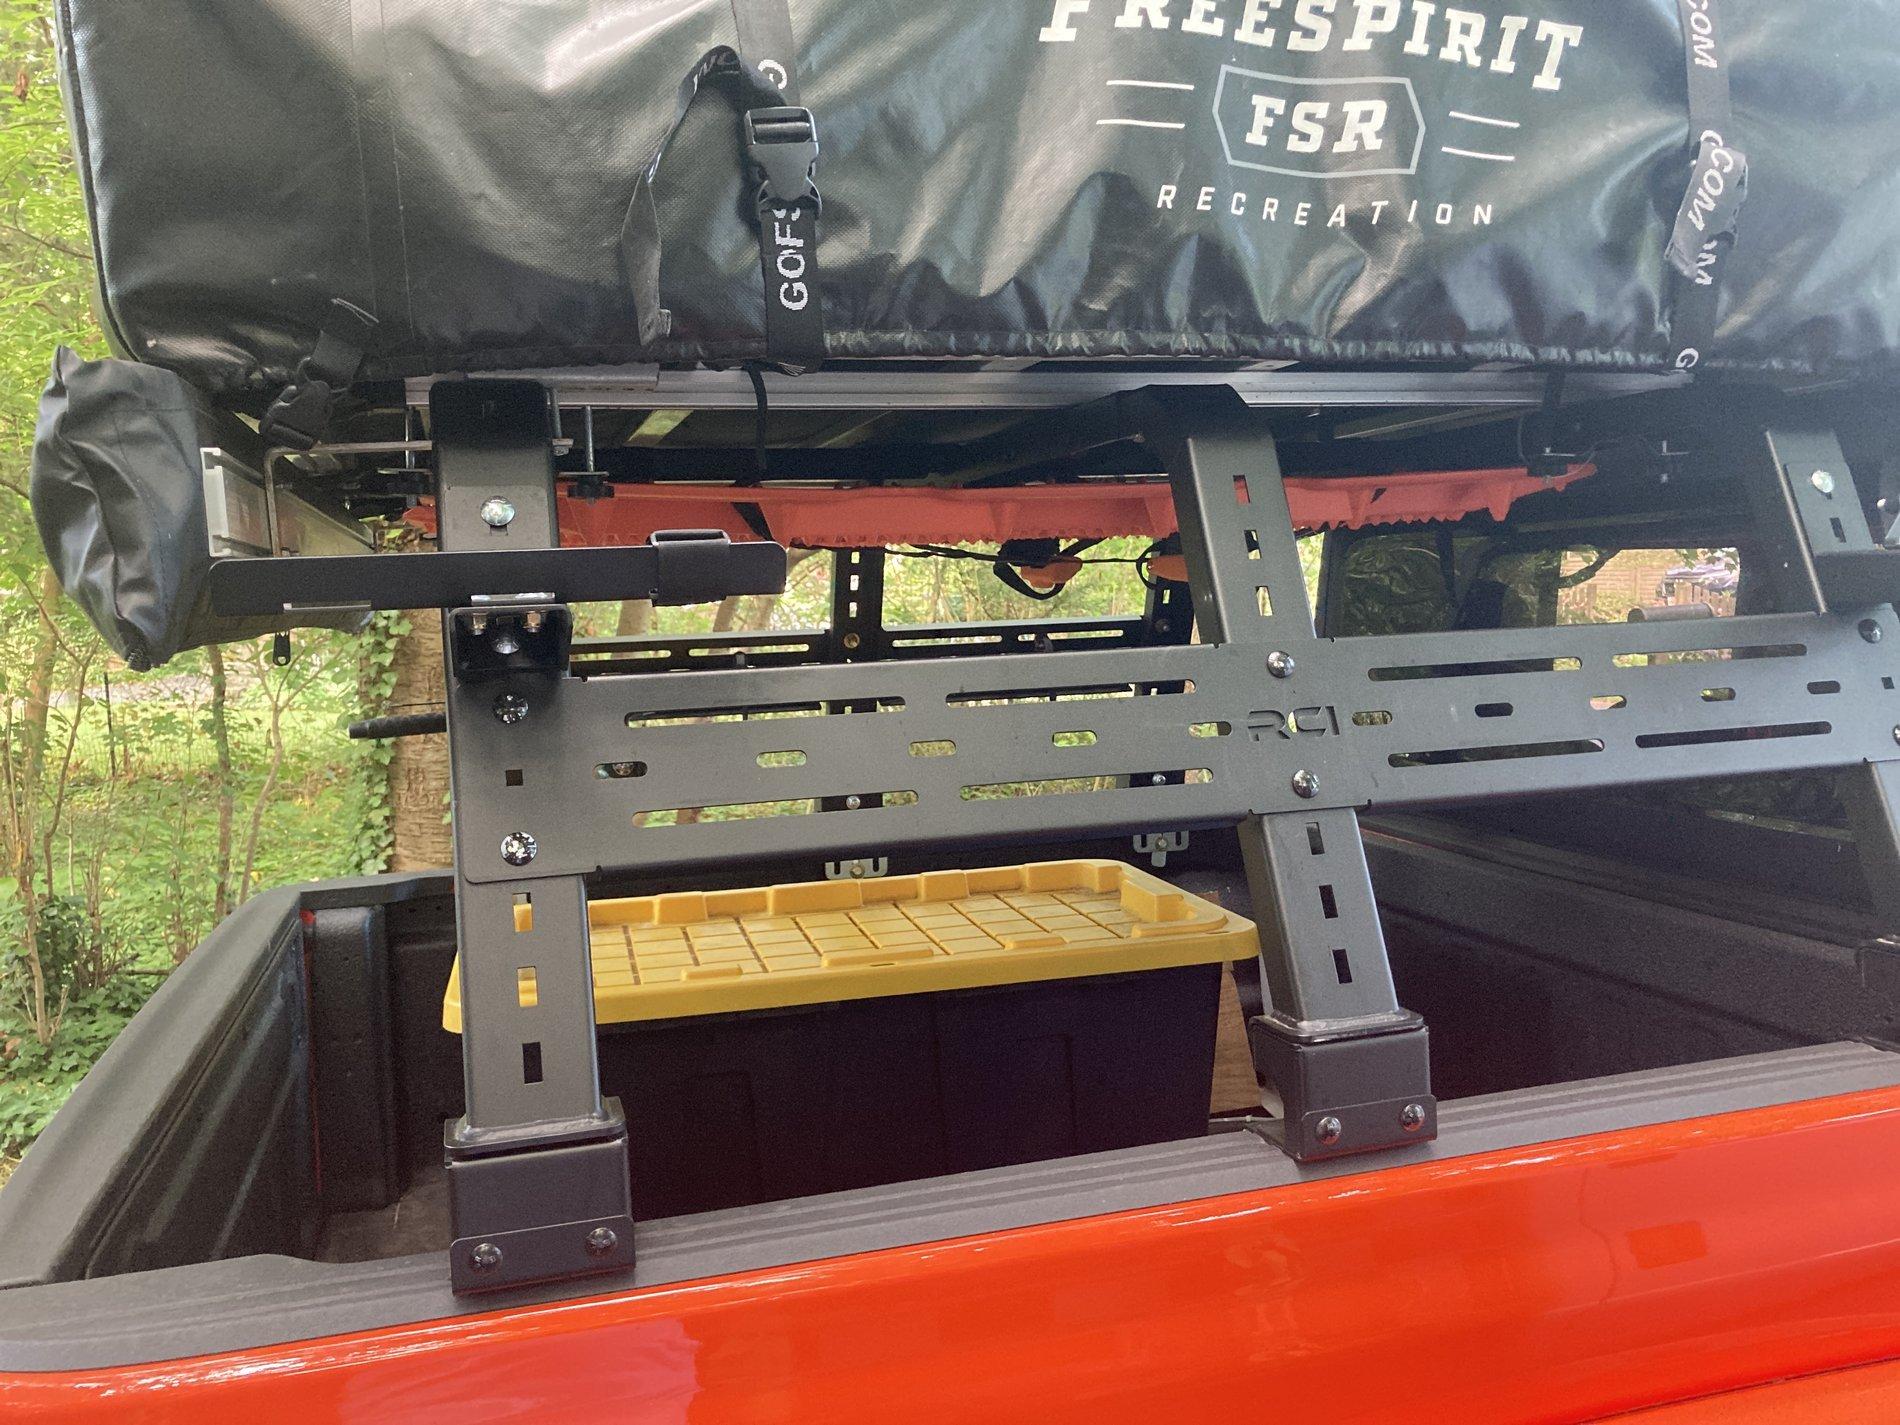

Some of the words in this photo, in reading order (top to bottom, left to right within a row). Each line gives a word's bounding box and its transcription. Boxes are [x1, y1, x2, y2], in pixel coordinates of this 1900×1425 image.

[1038, 0, 1583, 91] FREESPIRIT
[1245, 94, 1388, 153] FSR
[1156, 184, 1494, 228] RECREATION
[1248, 705, 1340, 742] RCI
